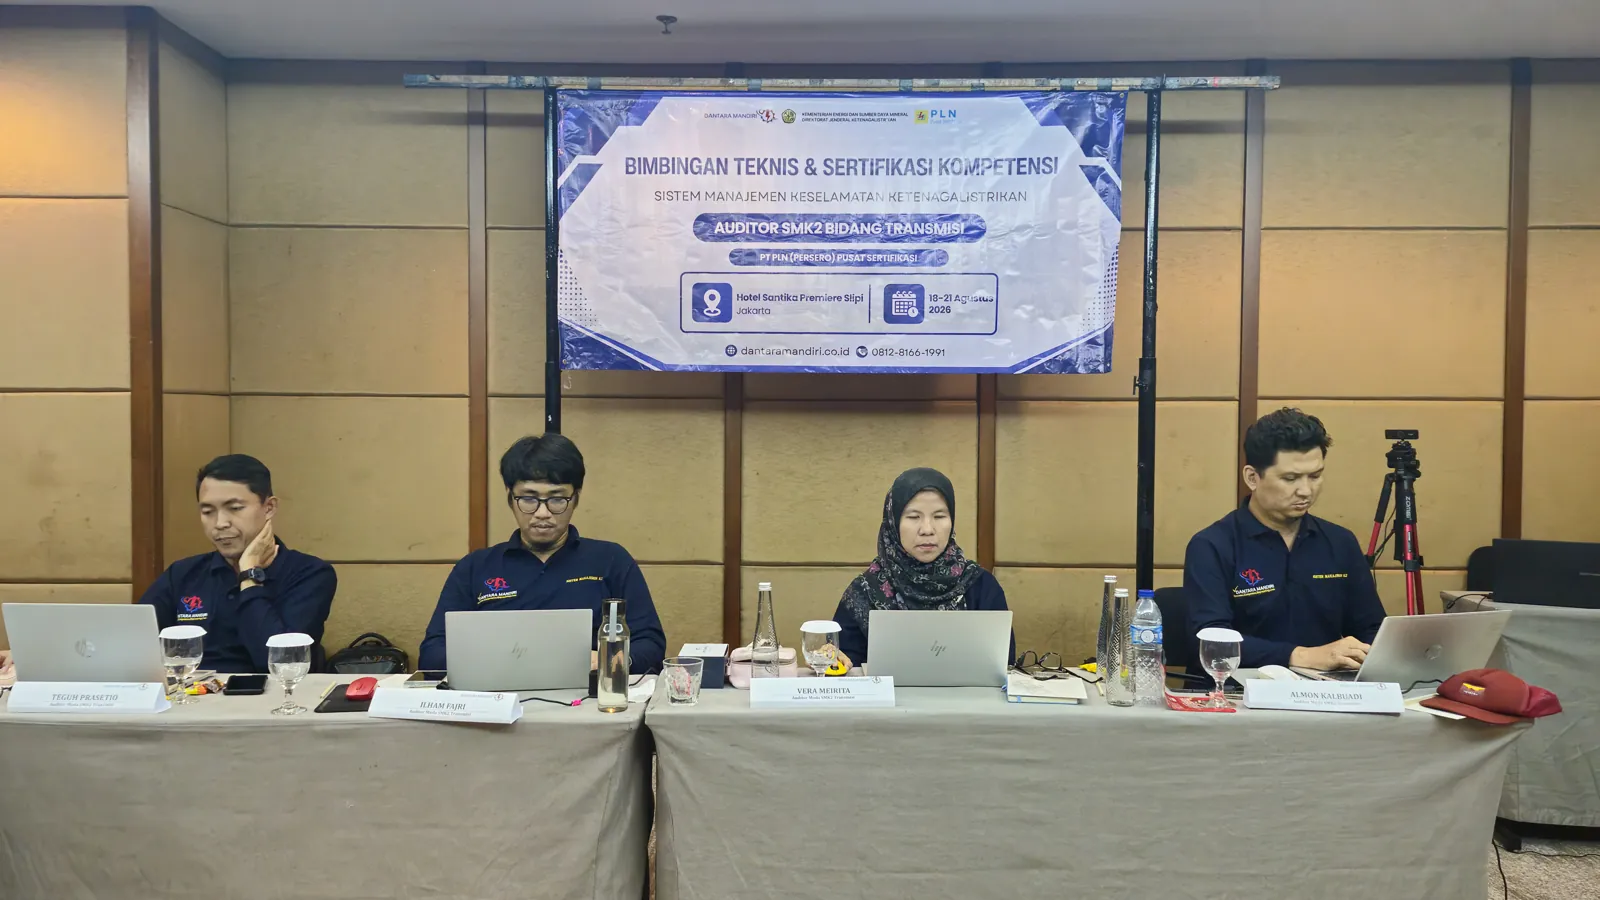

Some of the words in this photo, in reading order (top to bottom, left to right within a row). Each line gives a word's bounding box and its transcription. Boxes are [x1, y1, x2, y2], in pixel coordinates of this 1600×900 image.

[930, 109, 957, 118] PLN
[625, 157, 728, 175] BIMBINGAN
[734, 157, 799, 176] TEKNIS
[804, 157, 818, 176] &
[823, 157, 933, 176] SERTIFIKASI
[938, 156, 1059, 176] KOMPETENSI
[654, 190, 701, 202] SISTEM
[705, 191, 787, 202] MANAJEMEN
[790, 191, 884, 203] KESELAMATAN
[889, 191, 1027, 202] KETENAGALISTRIKAN
[714, 221, 779, 234] AUDITOR
[781, 221, 823, 235] SMK2
[825, 222, 882, 235] BIDANG
[885, 222, 965, 235] TRANSMISI
[760, 253, 771, 261] PT
[772, 253, 788, 261] PLN
[789, 252, 835, 263] (PERSERO)
[838, 254, 865, 262] PUSAT
[866, 254, 918, 262] SERTIFIKASI
[736, 293, 761, 302] Hotel
[762, 293, 799, 302] Santika
[800, 293, 843, 302] Premiere
[844, 293, 864, 304] Slipi
[736, 306, 771, 315] Jakarta
[928, 305, 951, 314] 2026
[740, 346, 850, 356] dantaramandiri.co.id
[871, 348, 946, 357] 0812-8166-1991
[1290, 691, 1319, 699] ALMON
[1320, 692, 1363, 700] KALBUADI
[420, 701, 446, 709] ILHAM
[446, 703, 466, 711] FAJRI
